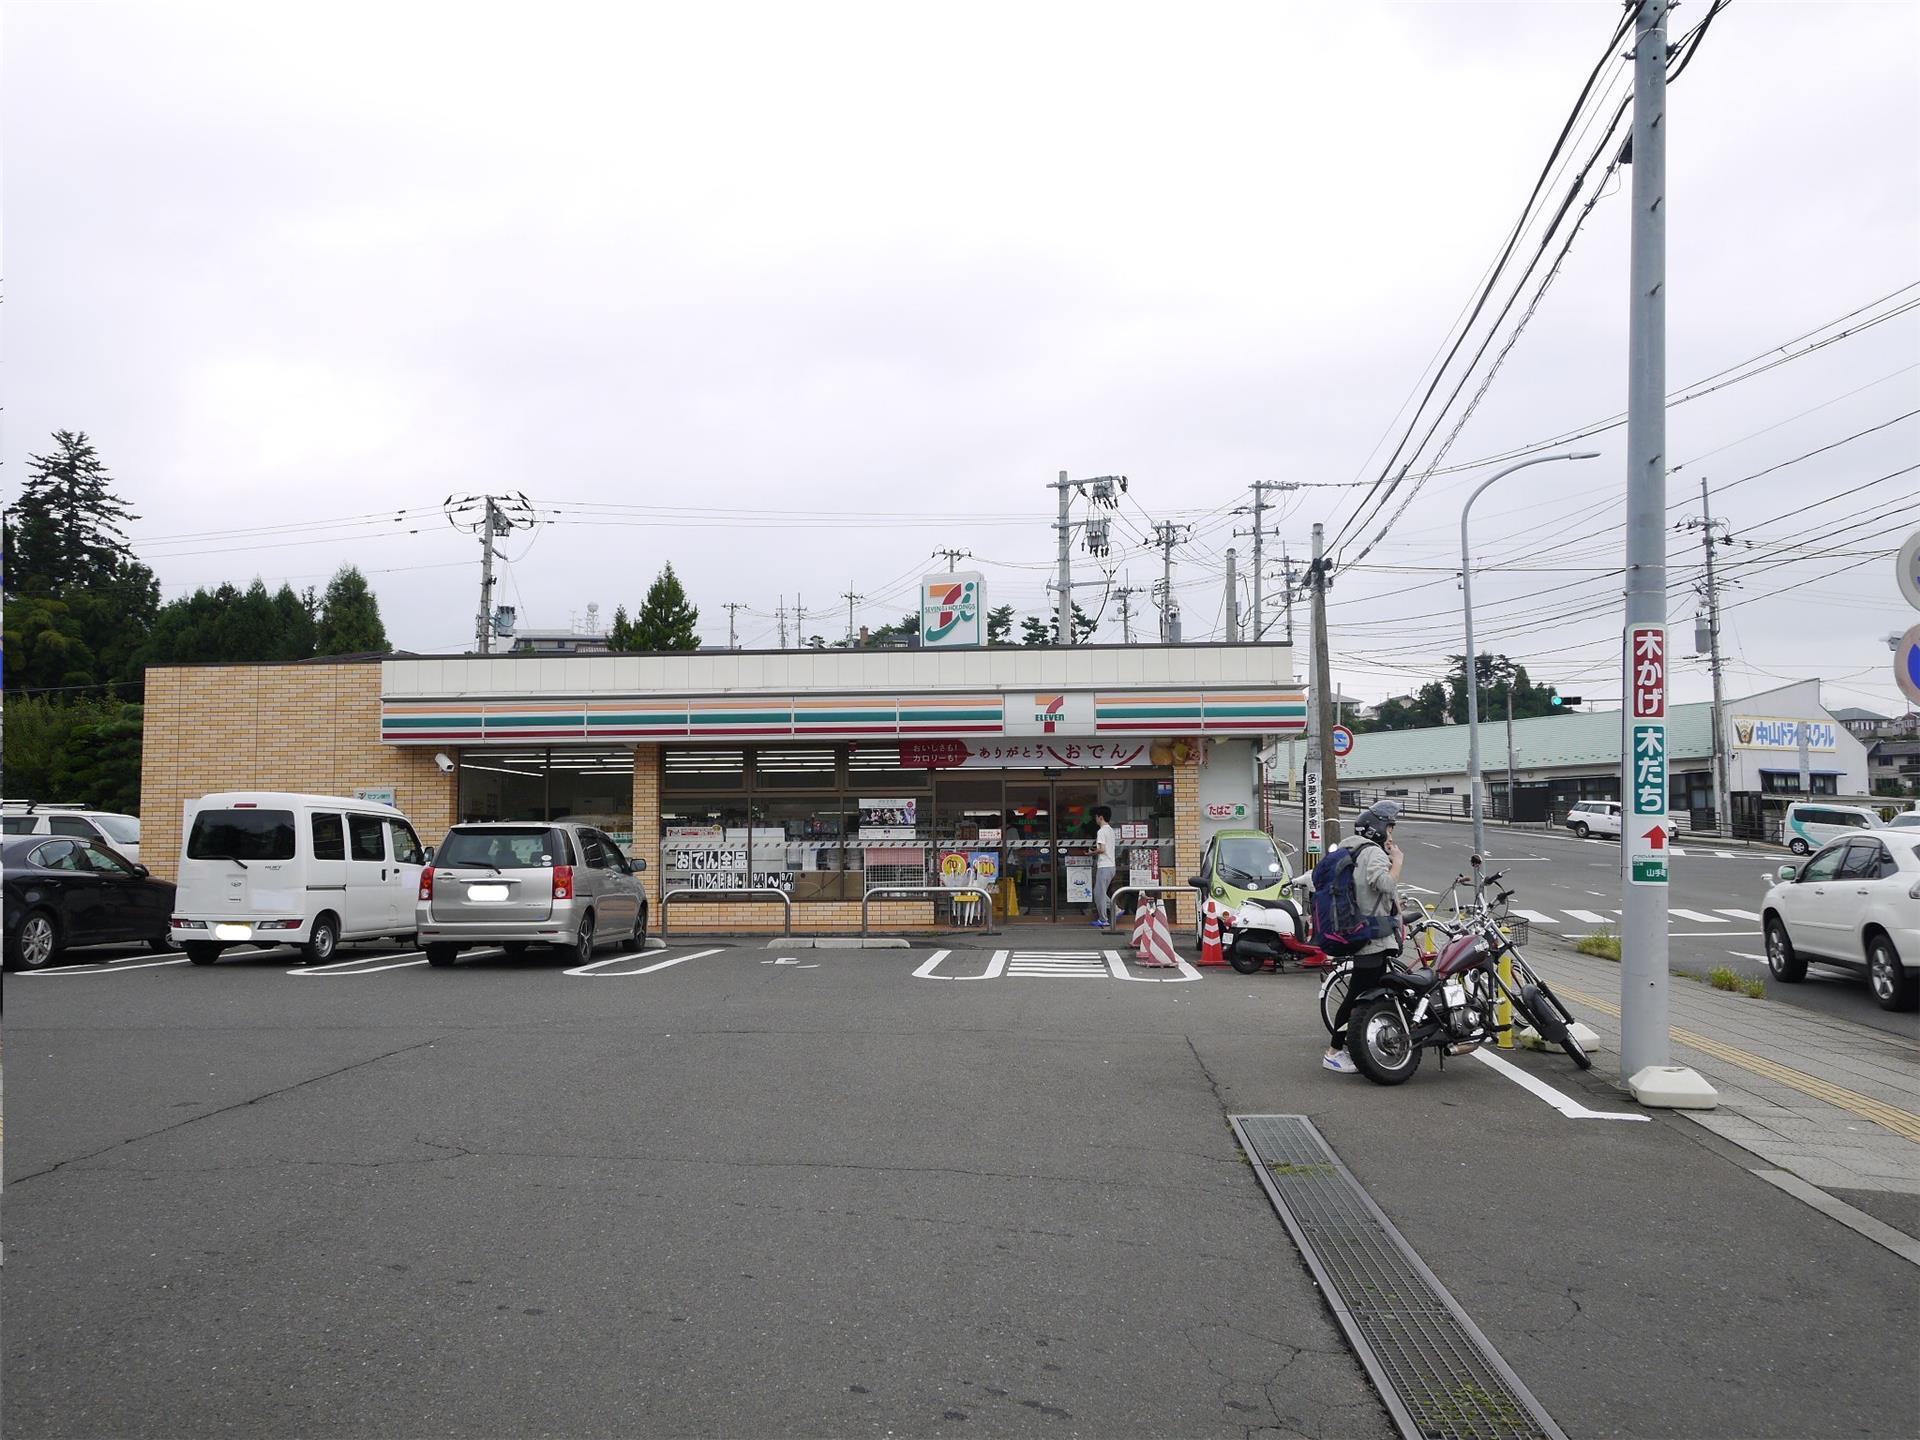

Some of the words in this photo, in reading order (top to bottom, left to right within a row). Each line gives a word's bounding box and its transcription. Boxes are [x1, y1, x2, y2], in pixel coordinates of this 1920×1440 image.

[1636, 631, 1663, 715] 木かげ
[1755, 721, 1835, 747] 中山ドライスクール
[979, 746, 1044, 759] ありがとう
[1065, 744, 1128, 759] おでん
[1636, 727, 1663, 812] 木だち
[1209, 805, 1231, 815] たばこ
[677, 851, 748, 870] おでん全品
